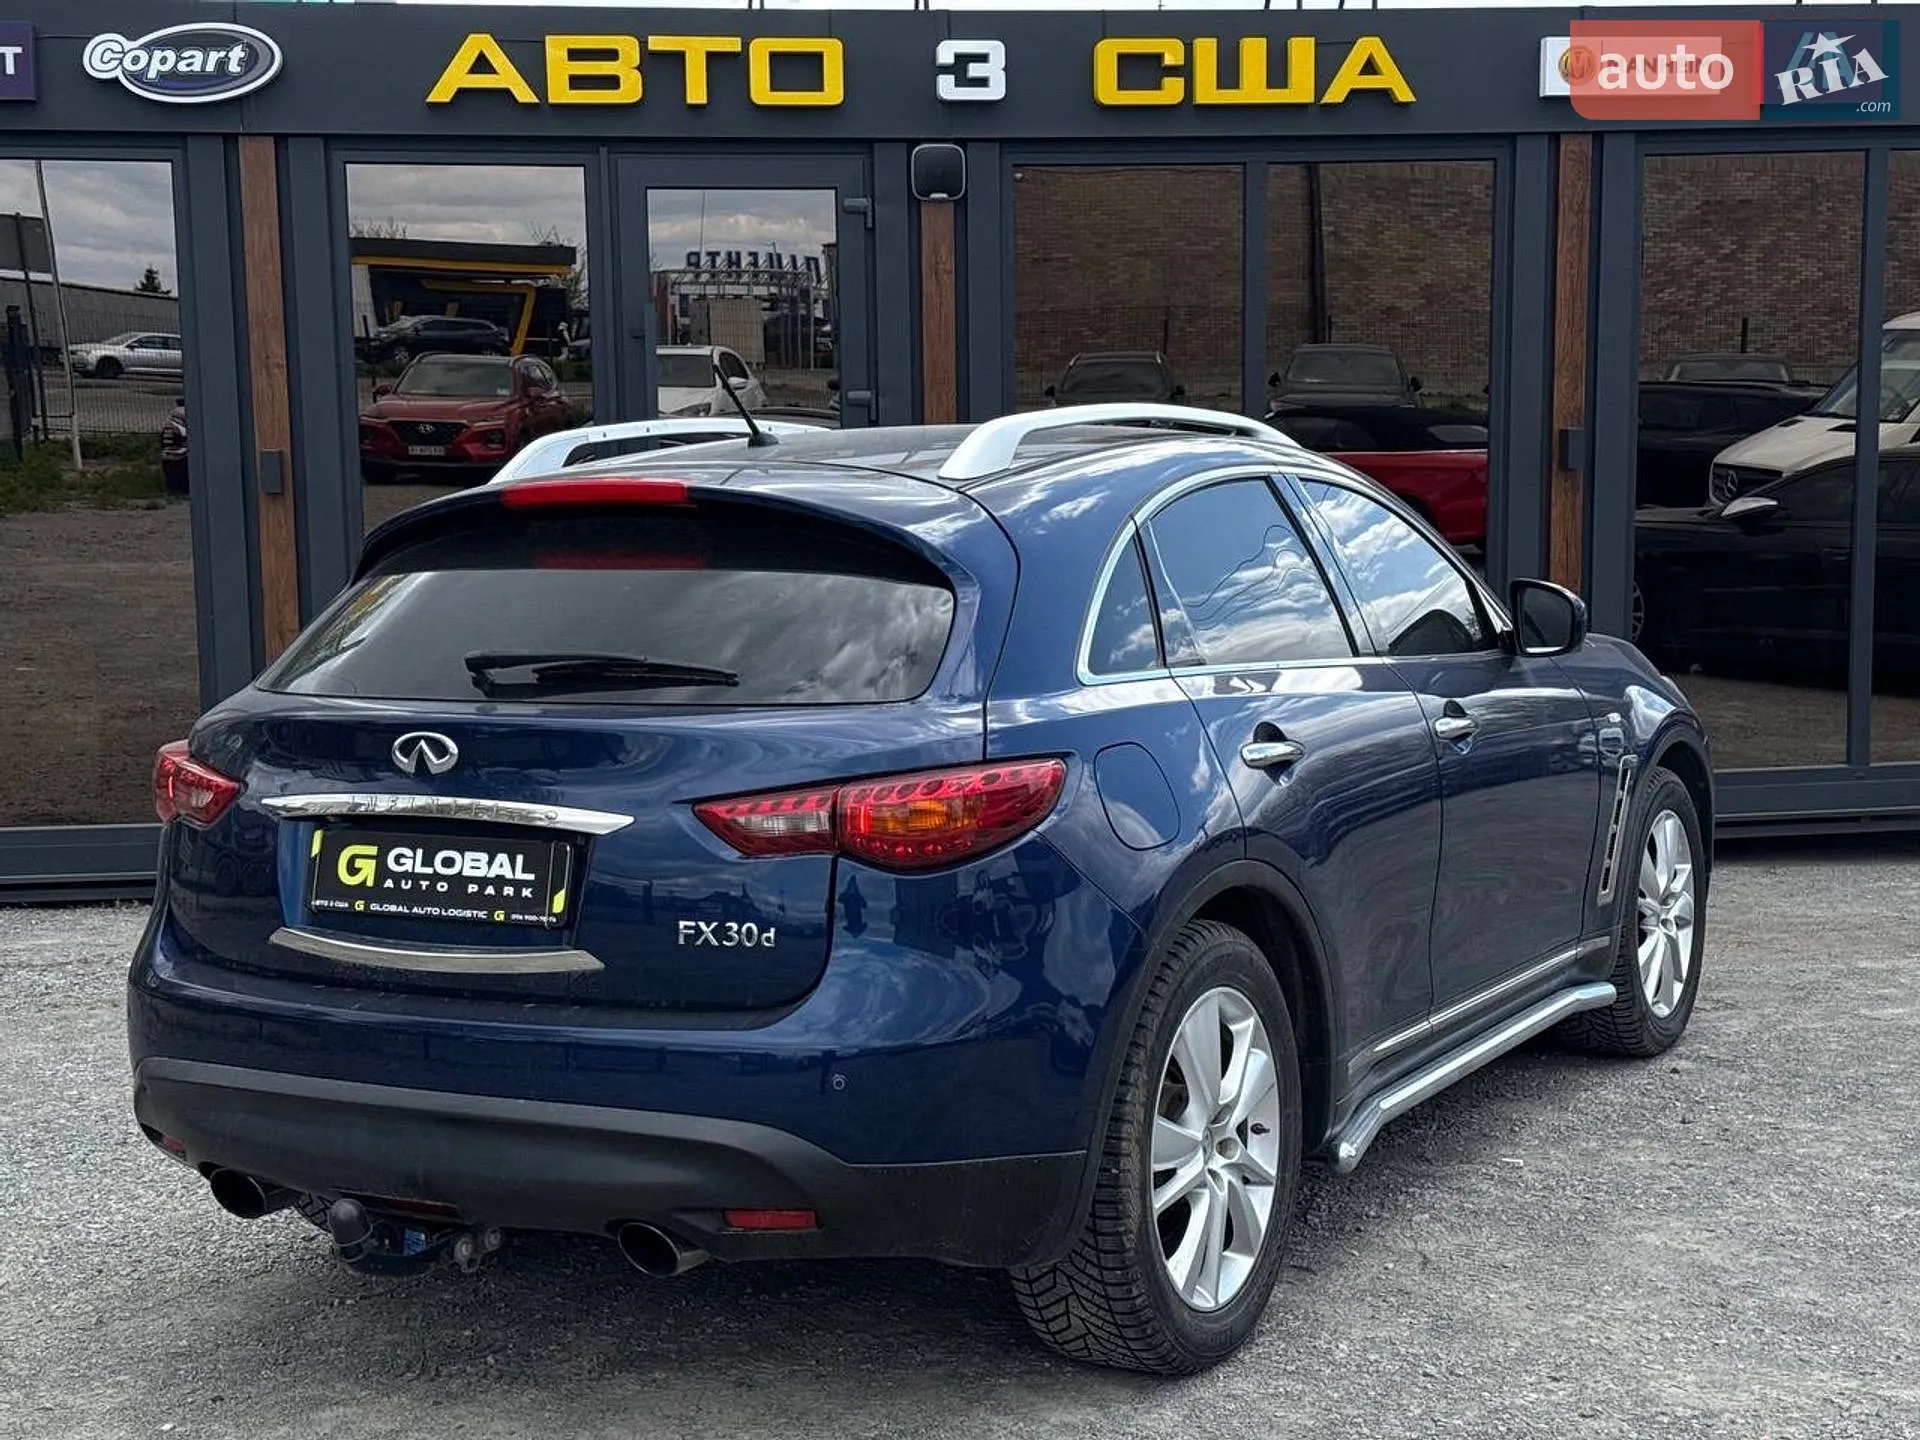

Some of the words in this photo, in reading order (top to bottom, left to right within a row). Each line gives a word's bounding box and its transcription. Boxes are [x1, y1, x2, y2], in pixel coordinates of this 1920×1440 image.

[90, 39, 247, 80] Copart
[427, 33, 845, 108] АВТО
[1094, 36, 1416, 106] США
[387, 847, 536, 881] GLOBAL
[383, 878, 450, 892] AUTO
[467, 883, 533, 898] PARK
[370, 903, 410, 913] GLOBAL
[411, 906, 440, 915] AUTO
[441, 908, 489, 919] LOGISTIC
